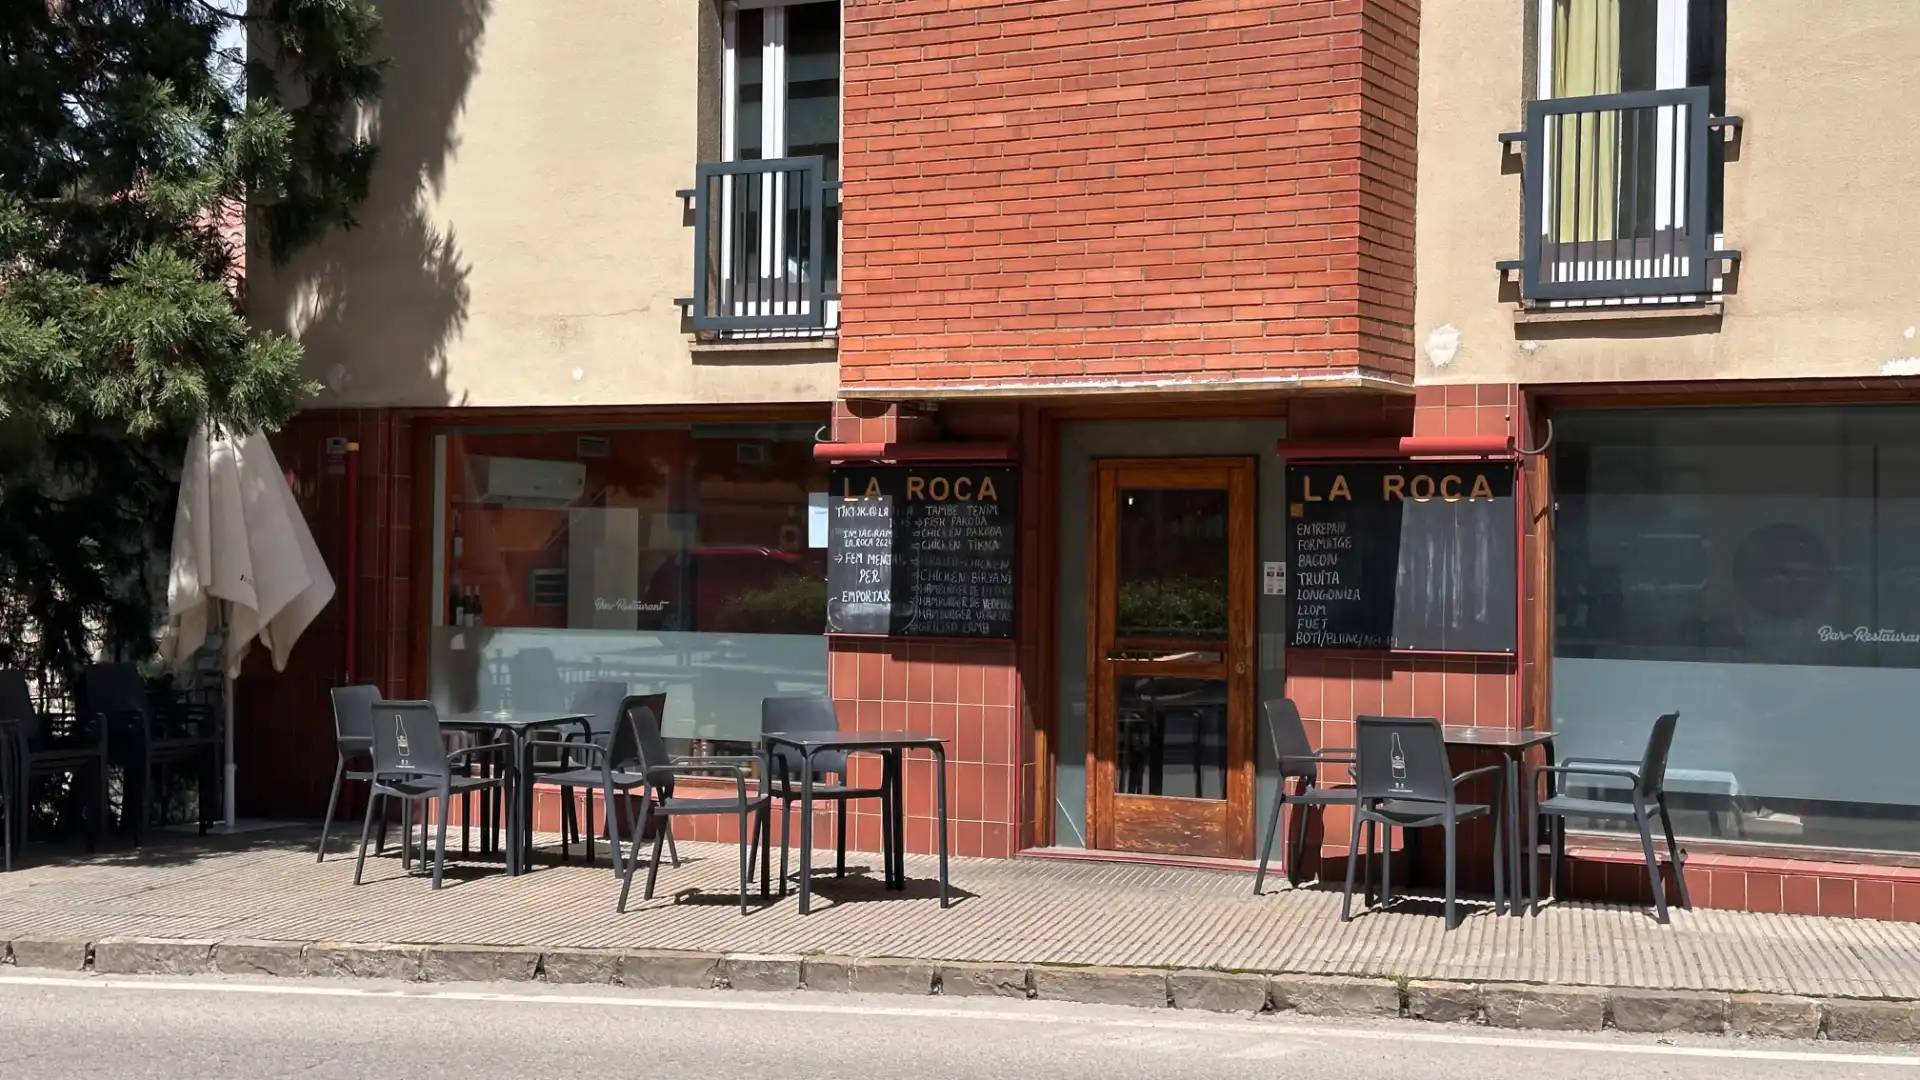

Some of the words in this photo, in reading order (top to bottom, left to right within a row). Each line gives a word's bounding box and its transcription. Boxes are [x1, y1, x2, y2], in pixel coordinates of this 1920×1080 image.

[843, 477, 883, 501] LA
[906, 476, 998, 501] ROCA
[1303, 475, 1352, 501] LA
[1383, 475, 1494, 502] ROCA
[1298, 553, 1338, 567] BACON
[858, 569, 881, 584] PER
[842, 590, 891, 603] EMPORTAR
[1297, 618, 1328, 630] FUET
